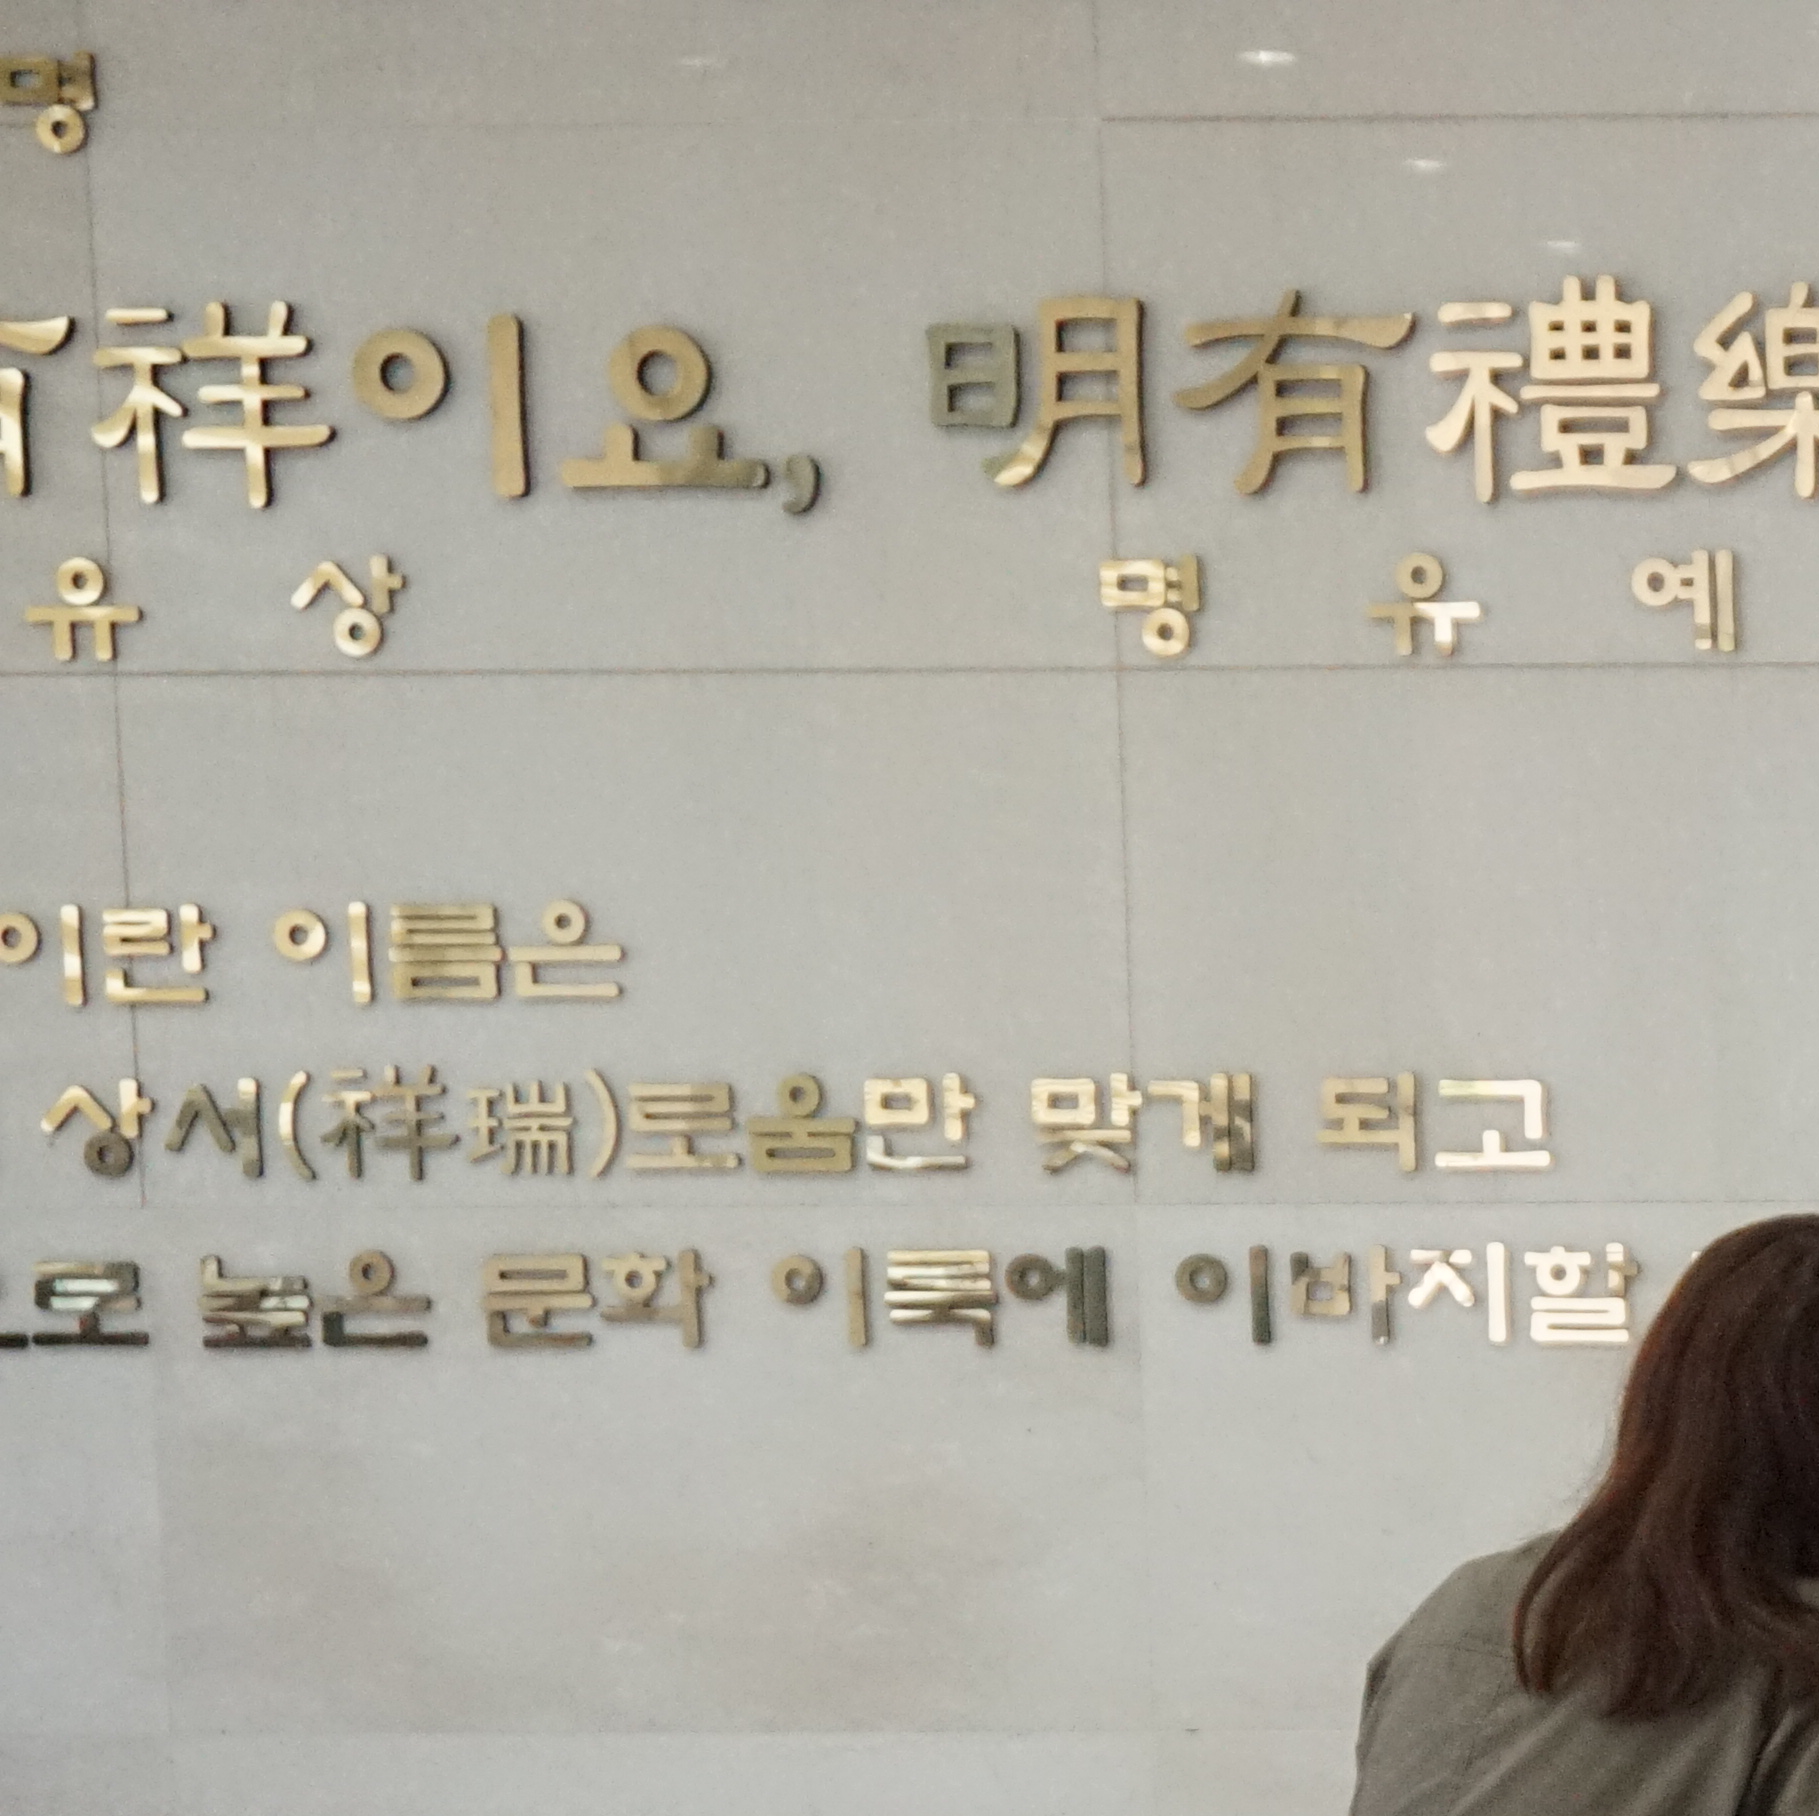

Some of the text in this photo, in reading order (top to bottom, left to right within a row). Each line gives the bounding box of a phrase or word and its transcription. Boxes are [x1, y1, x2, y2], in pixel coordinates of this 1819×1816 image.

[25, 556, 141, 662] 유
[290, 554, 405, 658] 상
[1098, 552, 1201, 658] 명
[1366, 552, 1482, 656] 유
[1631, 548, 1736, 652] 예
[273, 899, 623, 1004] 이름은
[1030, 1070, 1253, 1173] 맞게
[1317, 1070, 1551, 1172] 되고
[0, 1260, 150, 1348] 로
[200, 1250, 432, 1348] 높은
[482, 1246, 715, 1349] 문화
[771, 1244, 1112, 1348] 이룩에
[1174, 1240, 1638, 1347] 이바지할
